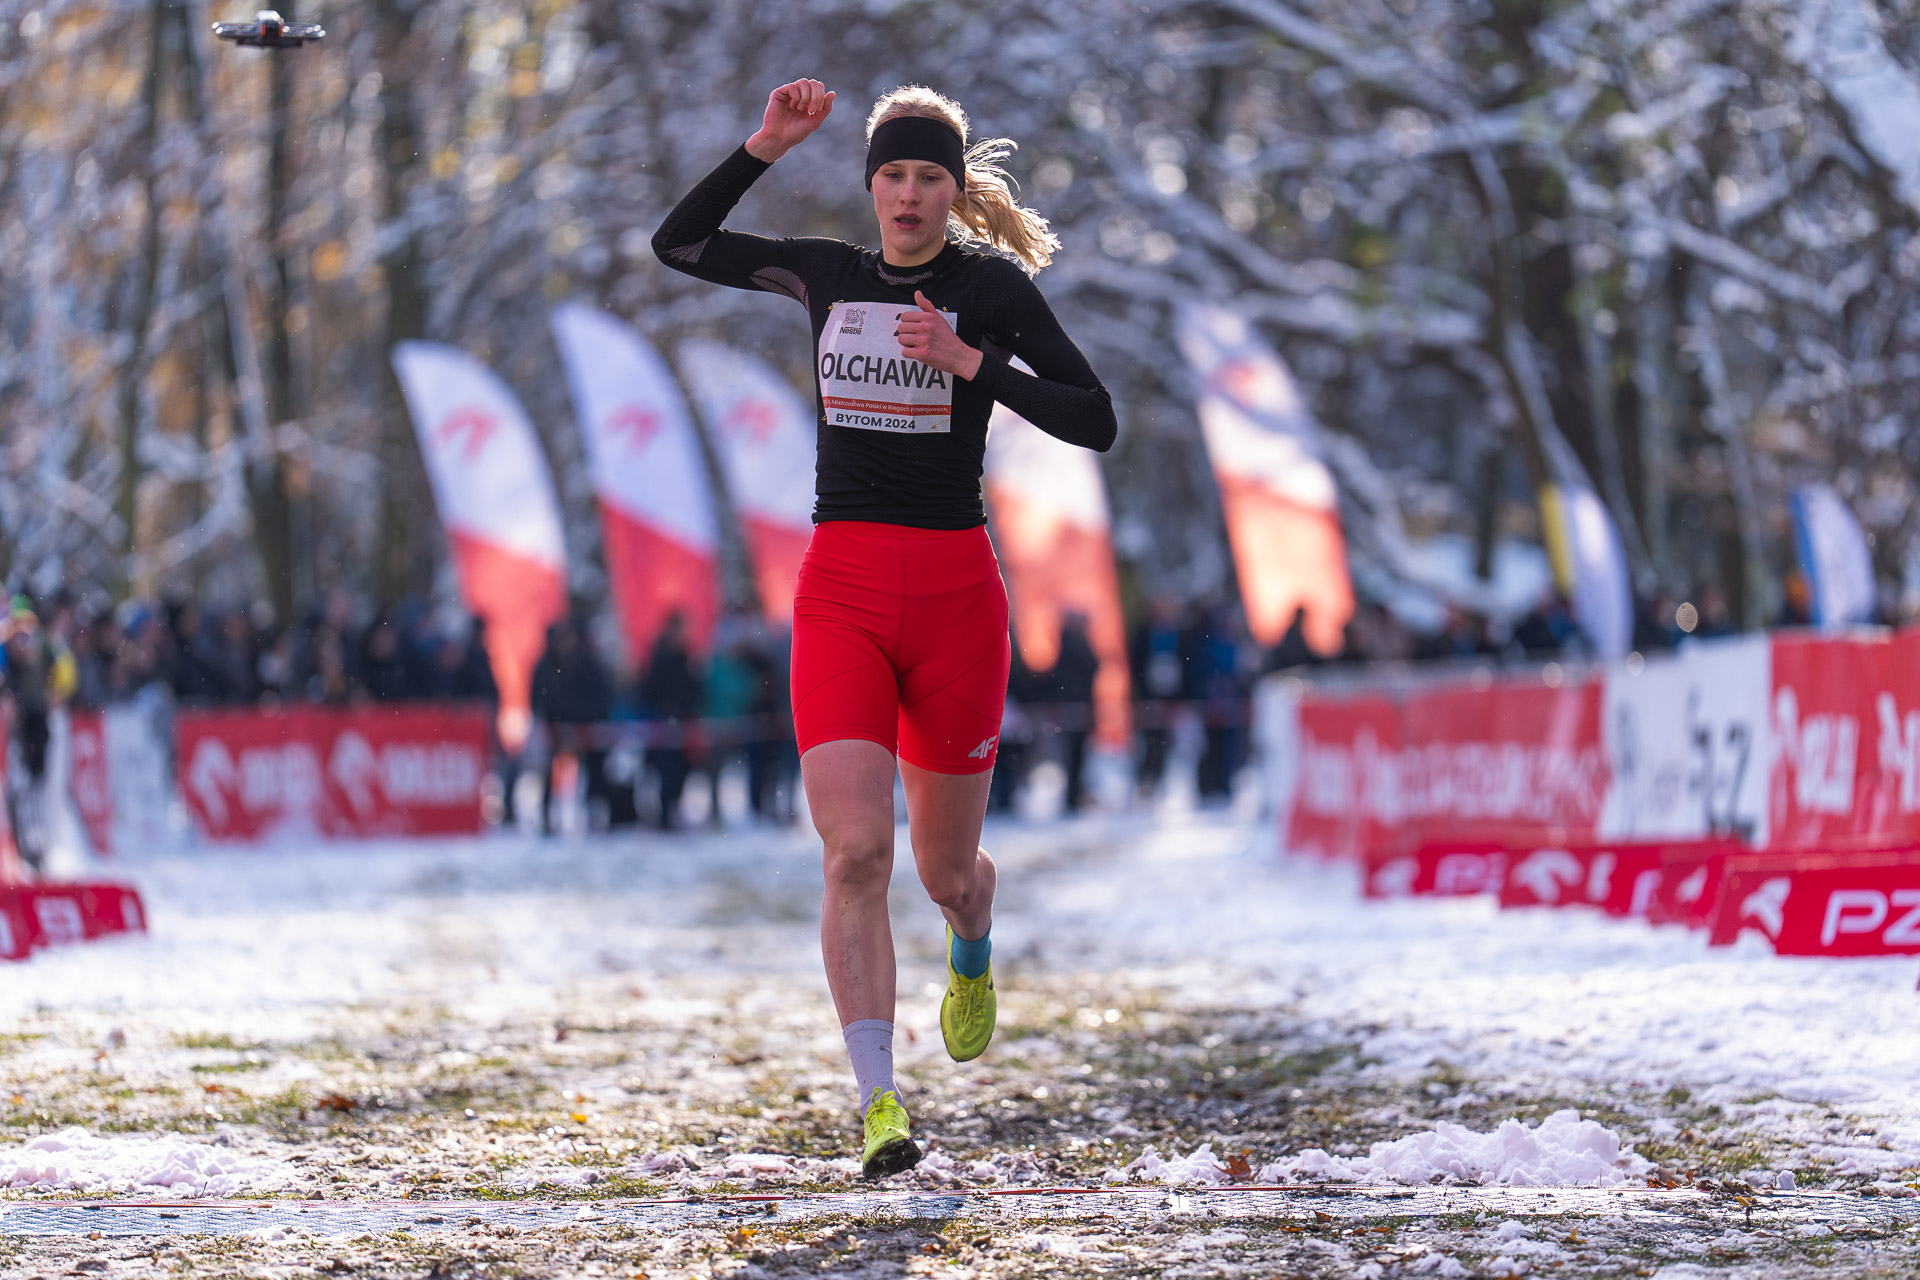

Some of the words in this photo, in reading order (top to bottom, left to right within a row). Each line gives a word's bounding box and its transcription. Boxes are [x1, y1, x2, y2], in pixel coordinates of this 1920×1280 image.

[821, 352, 946, 390] OLCHAWA
[888, 404, 910, 412] Biegach
[836, 413, 882, 427] BYTOM
[884, 418, 916, 430] 2024
[968, 735, 998, 759] 4F
